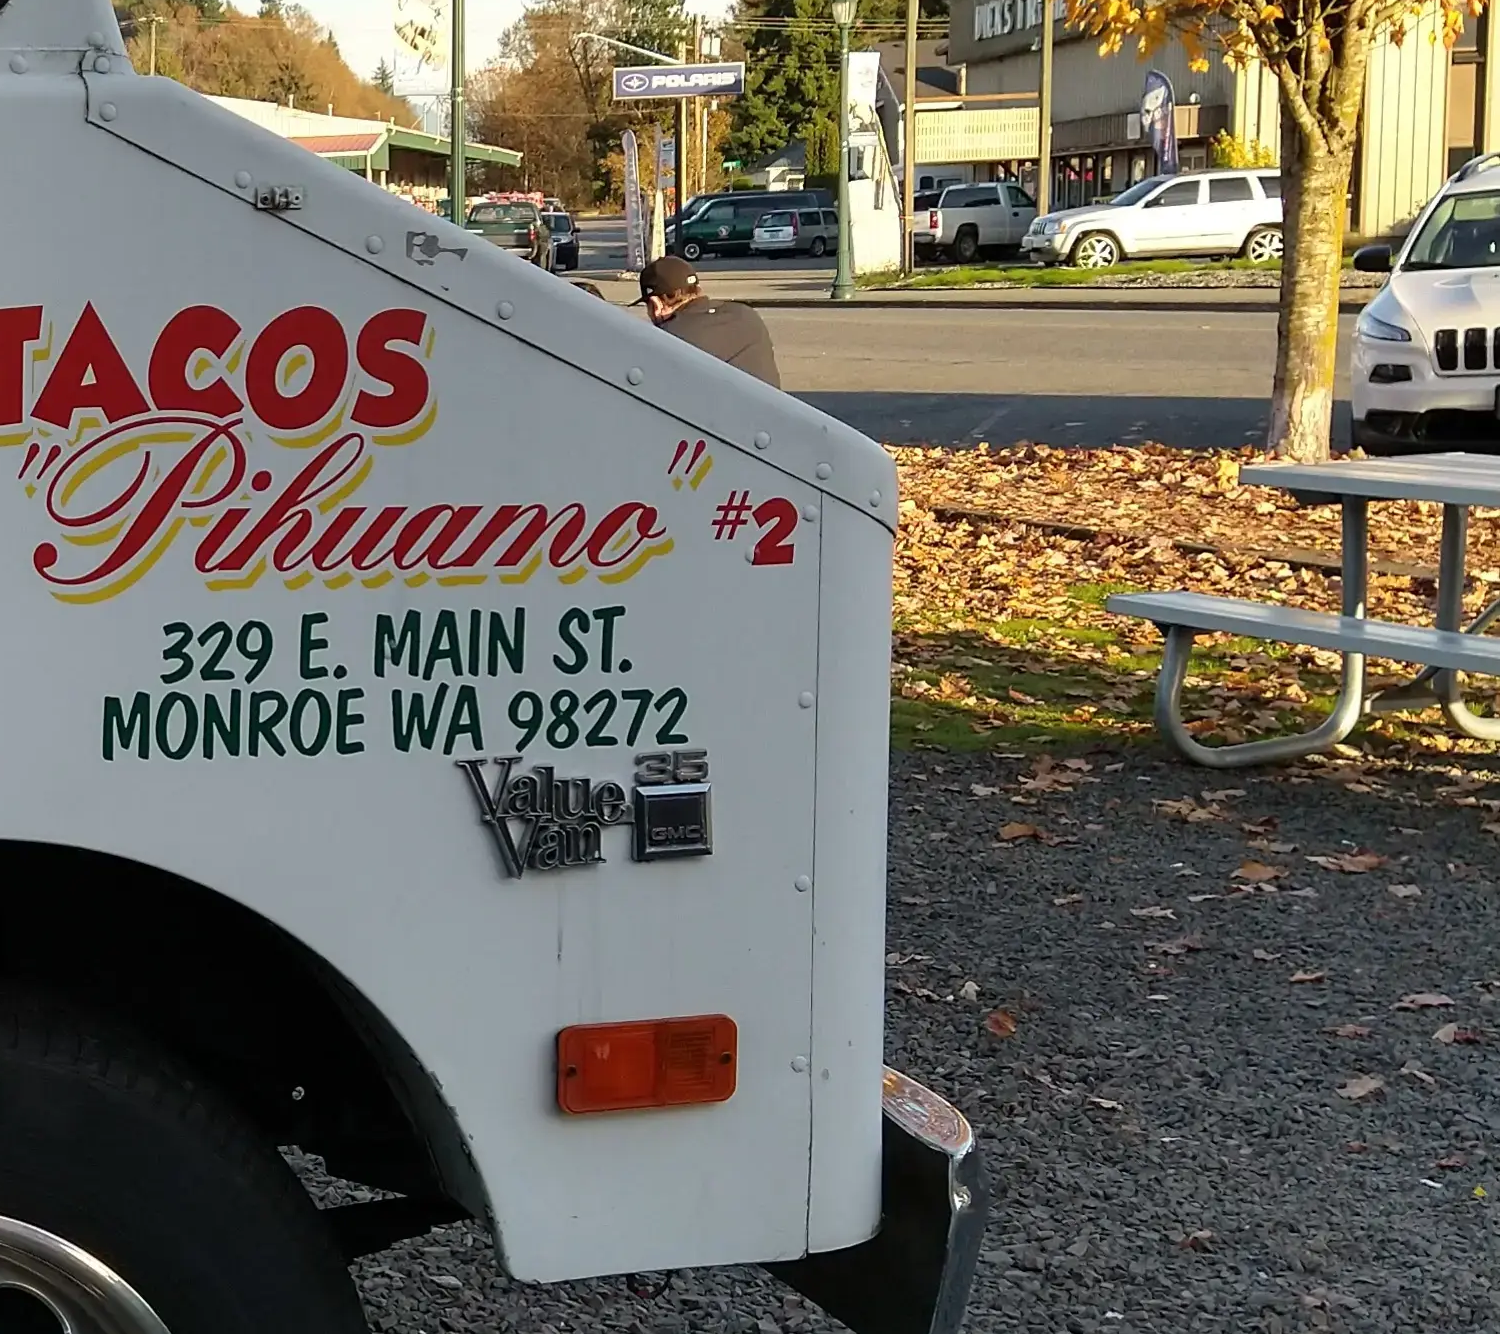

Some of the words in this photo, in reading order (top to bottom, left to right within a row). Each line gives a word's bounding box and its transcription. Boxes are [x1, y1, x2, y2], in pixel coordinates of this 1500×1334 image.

[652, 72, 736, 88] POLARIS
[711, 491, 799, 566] #2
[160, 619, 273, 685] 329
[299, 612, 348, 680] E.
[374, 606, 526, 681] MAIN
[552, 605, 633, 675] ST.
[102, 687, 365, 762] MONROE
[391, 682, 484, 756] WA
[507, 687, 689, 754] 98272
[454, 755, 627, 824] Value
[634, 749, 709, 783] 35
[494, 814, 607, 879] Van
[651, 825, 702, 841] GMC
